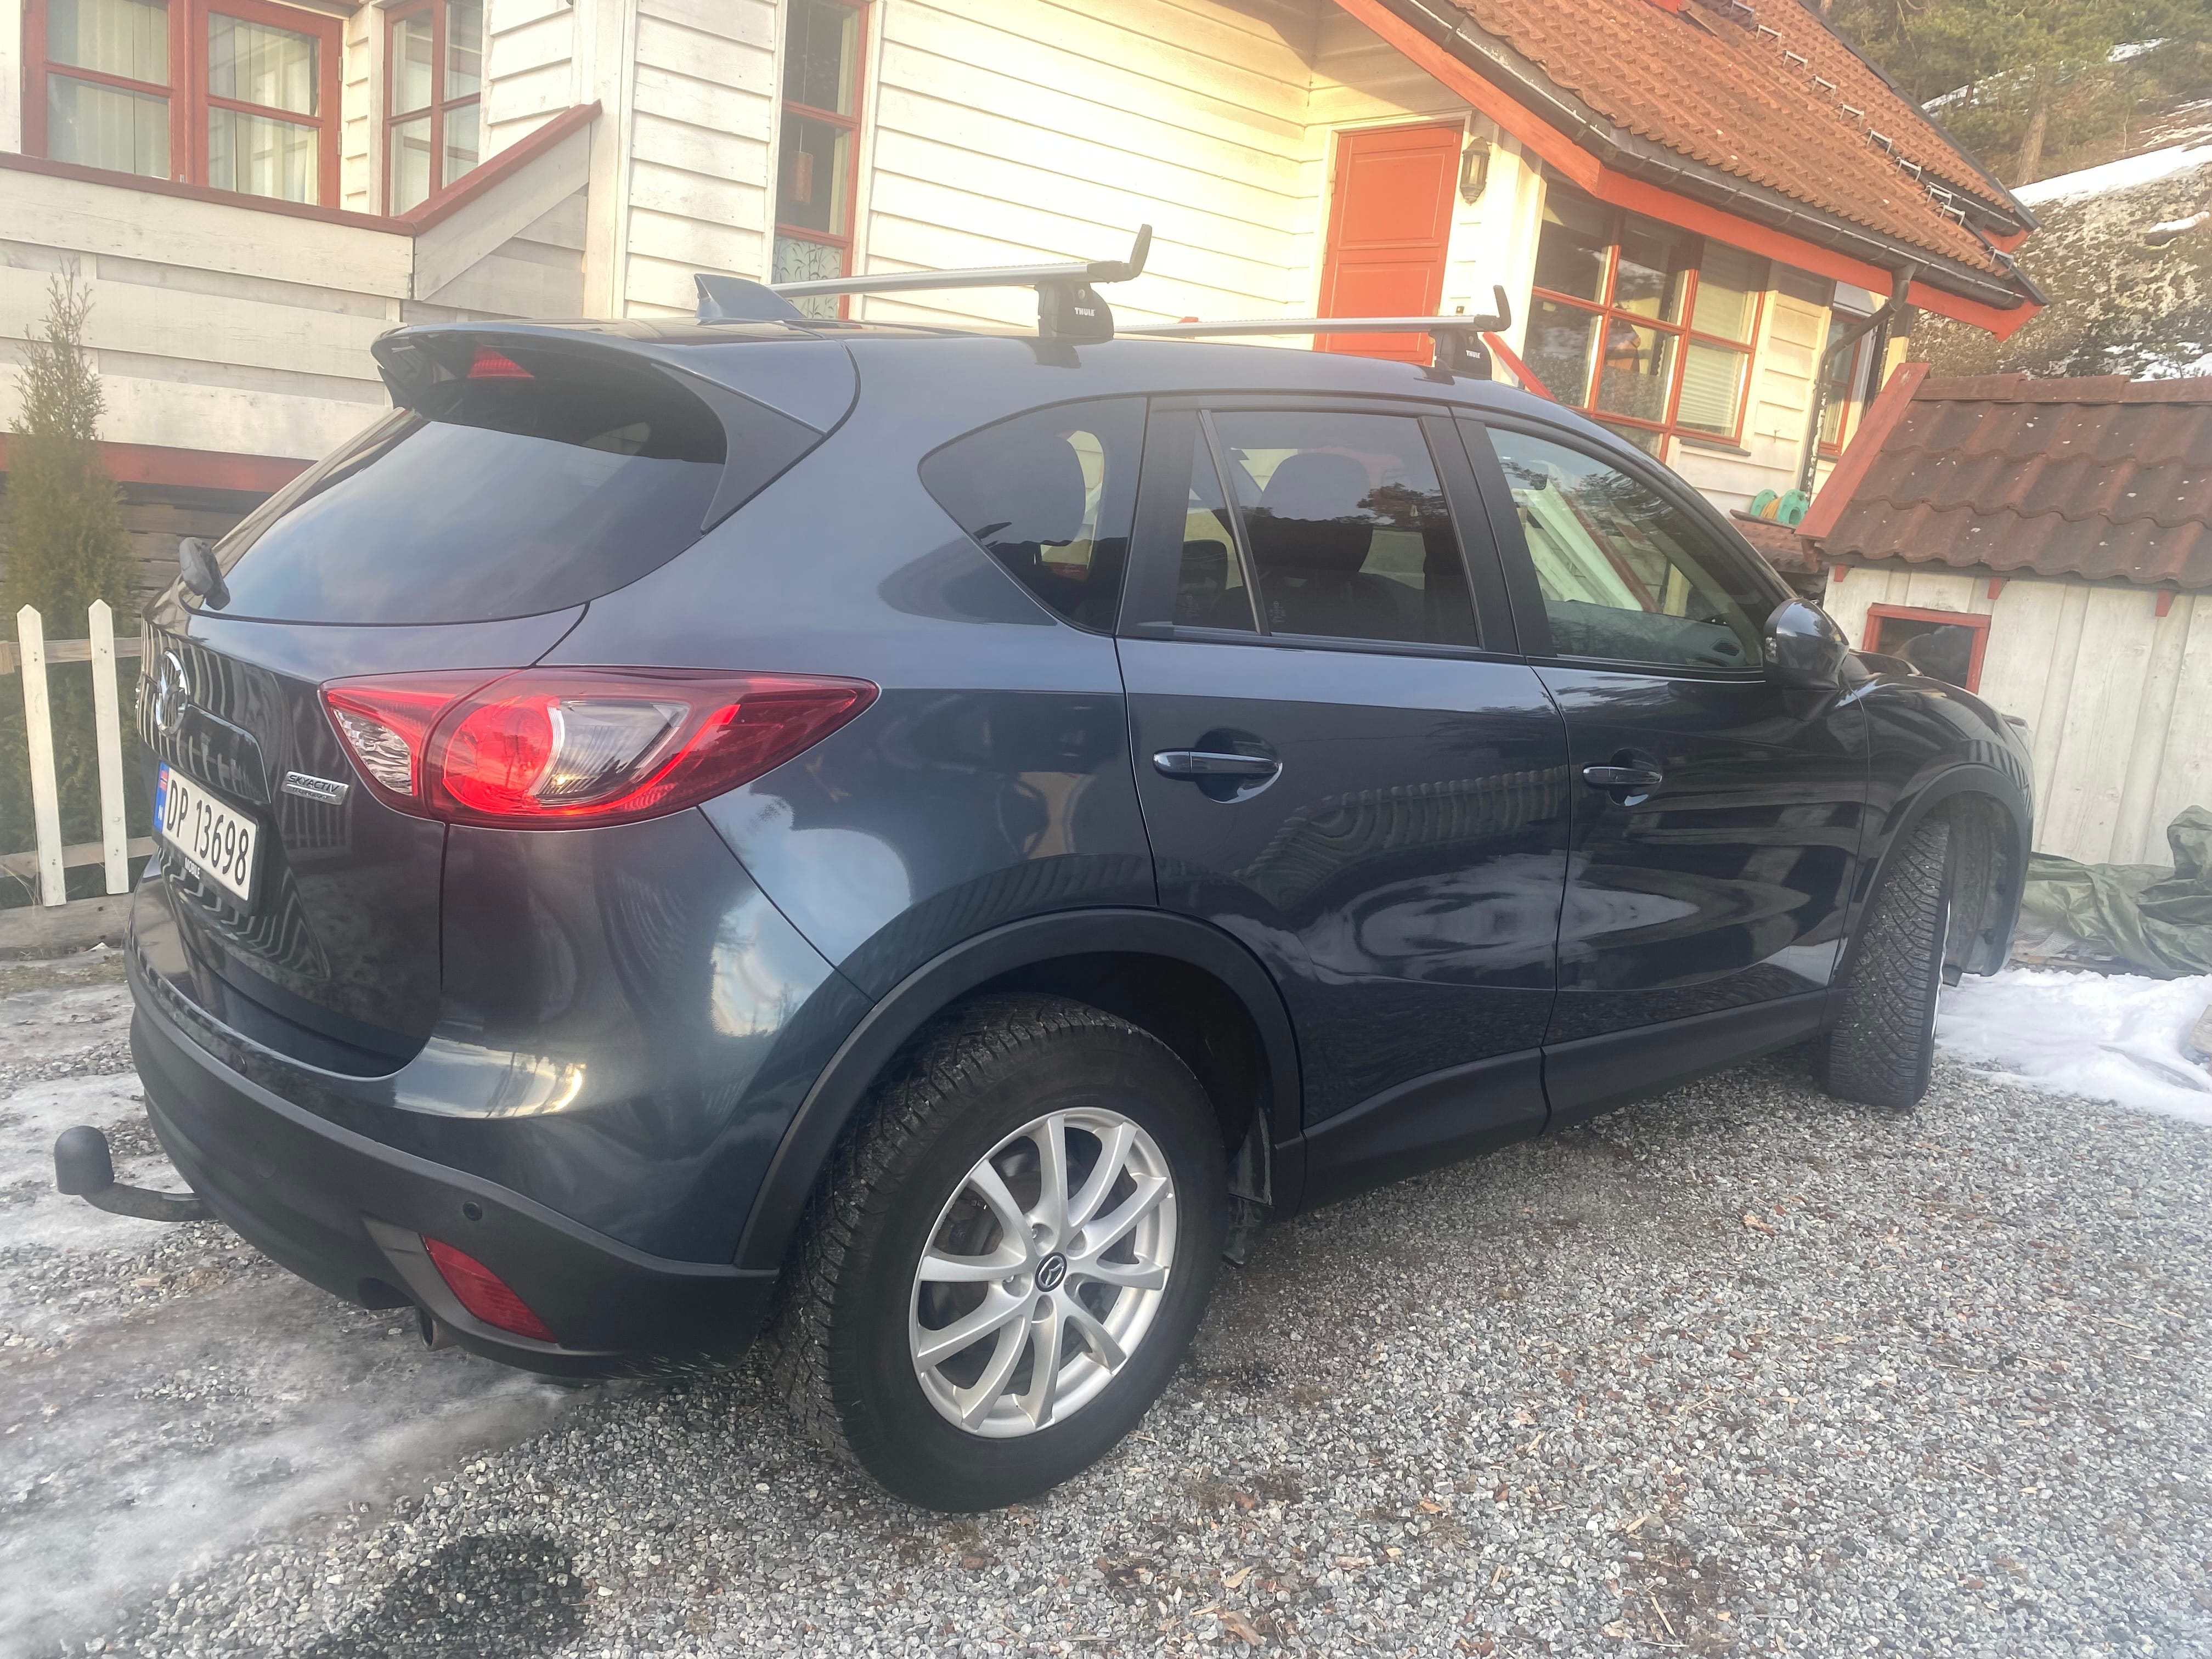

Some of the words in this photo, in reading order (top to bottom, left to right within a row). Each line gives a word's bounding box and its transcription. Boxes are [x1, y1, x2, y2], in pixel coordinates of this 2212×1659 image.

[1074, 307, 1095, 317] THULE
[1466, 349, 1480, 359] THULE
[287, 775, 340, 792] SKYACTIV
[158, 805, 163, 821] N
[167, 779, 189, 838] DP
[194, 799, 249, 885] 13698
[184, 857, 200, 879] MOBILE
